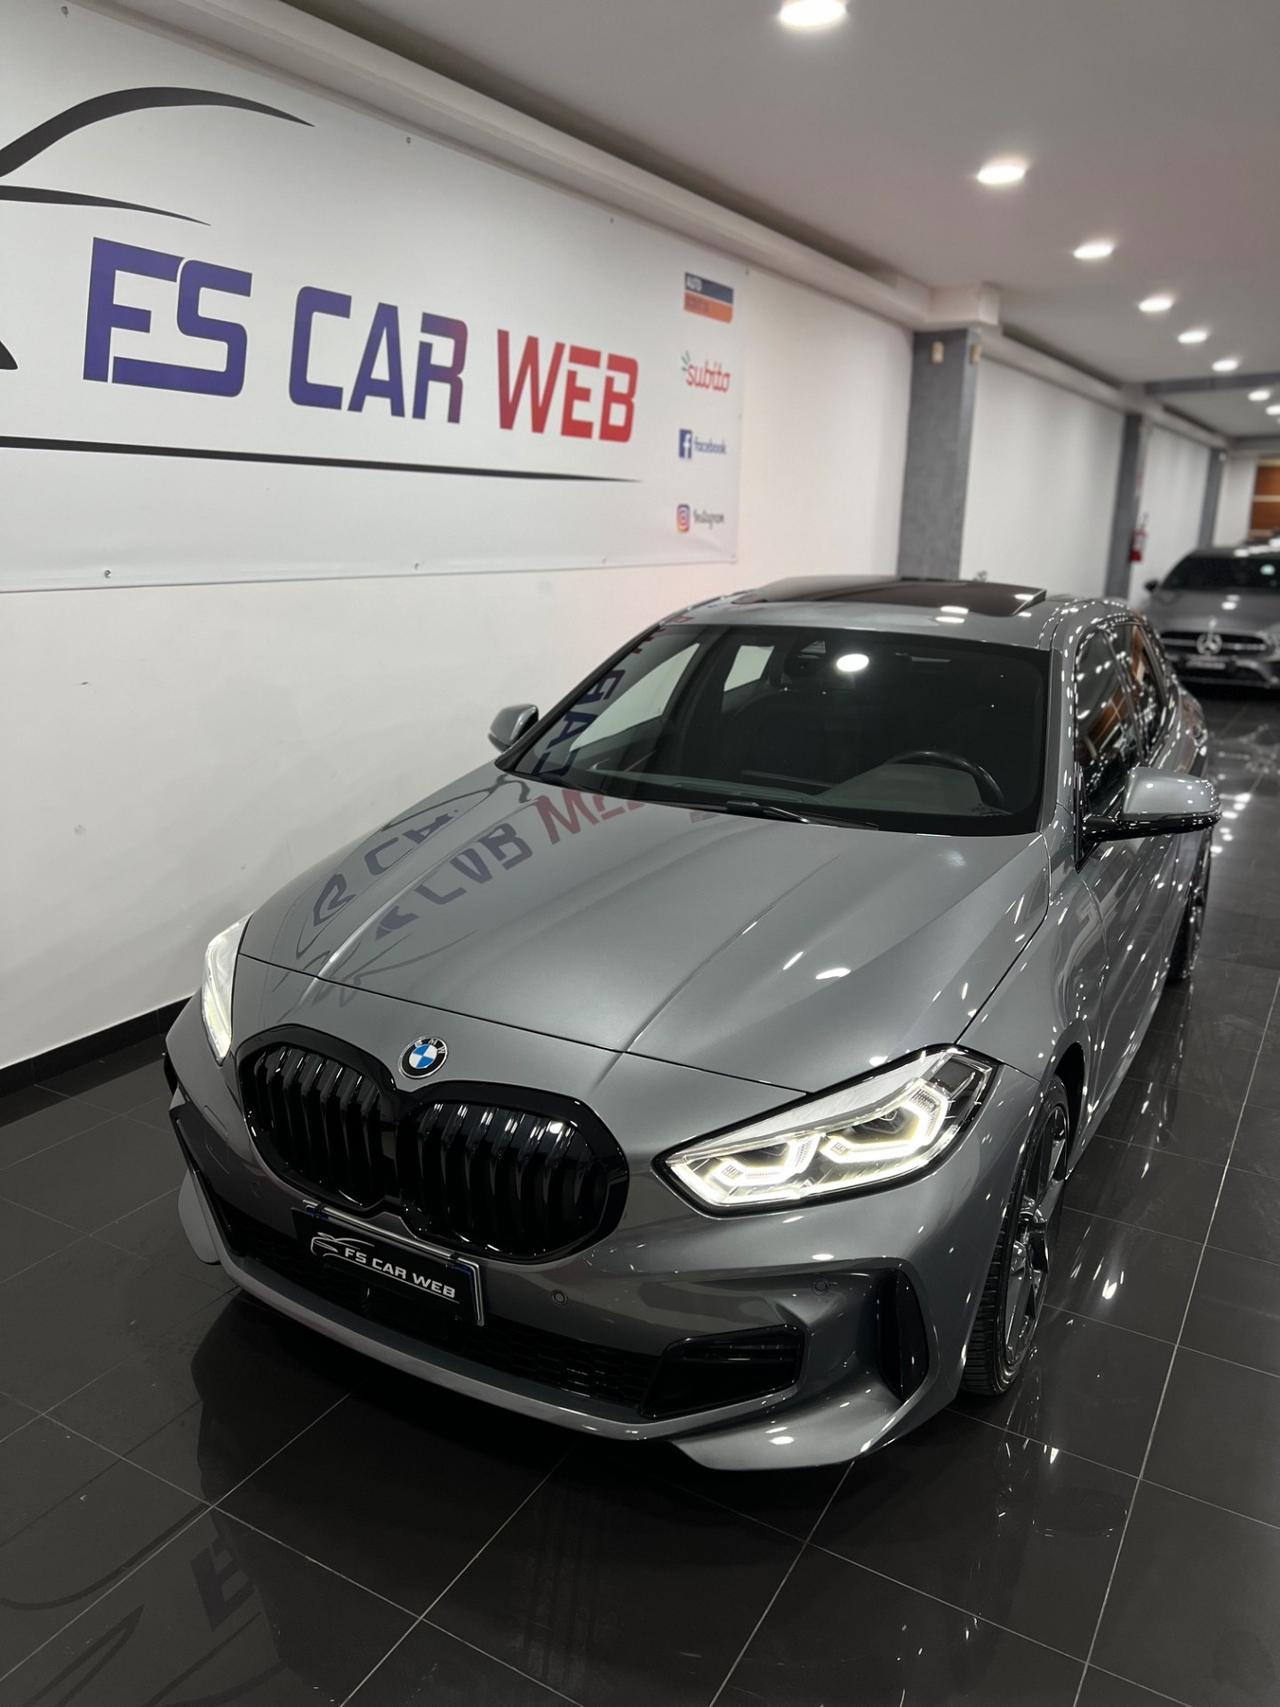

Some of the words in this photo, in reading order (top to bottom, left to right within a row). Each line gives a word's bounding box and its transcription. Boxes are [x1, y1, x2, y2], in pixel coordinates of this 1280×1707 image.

[289, 286, 468, 424] CAR
[497, 328, 638, 443] WEB
[372, 1258, 407, 1279] CAR
[412, 1272, 455, 1298] WEB
